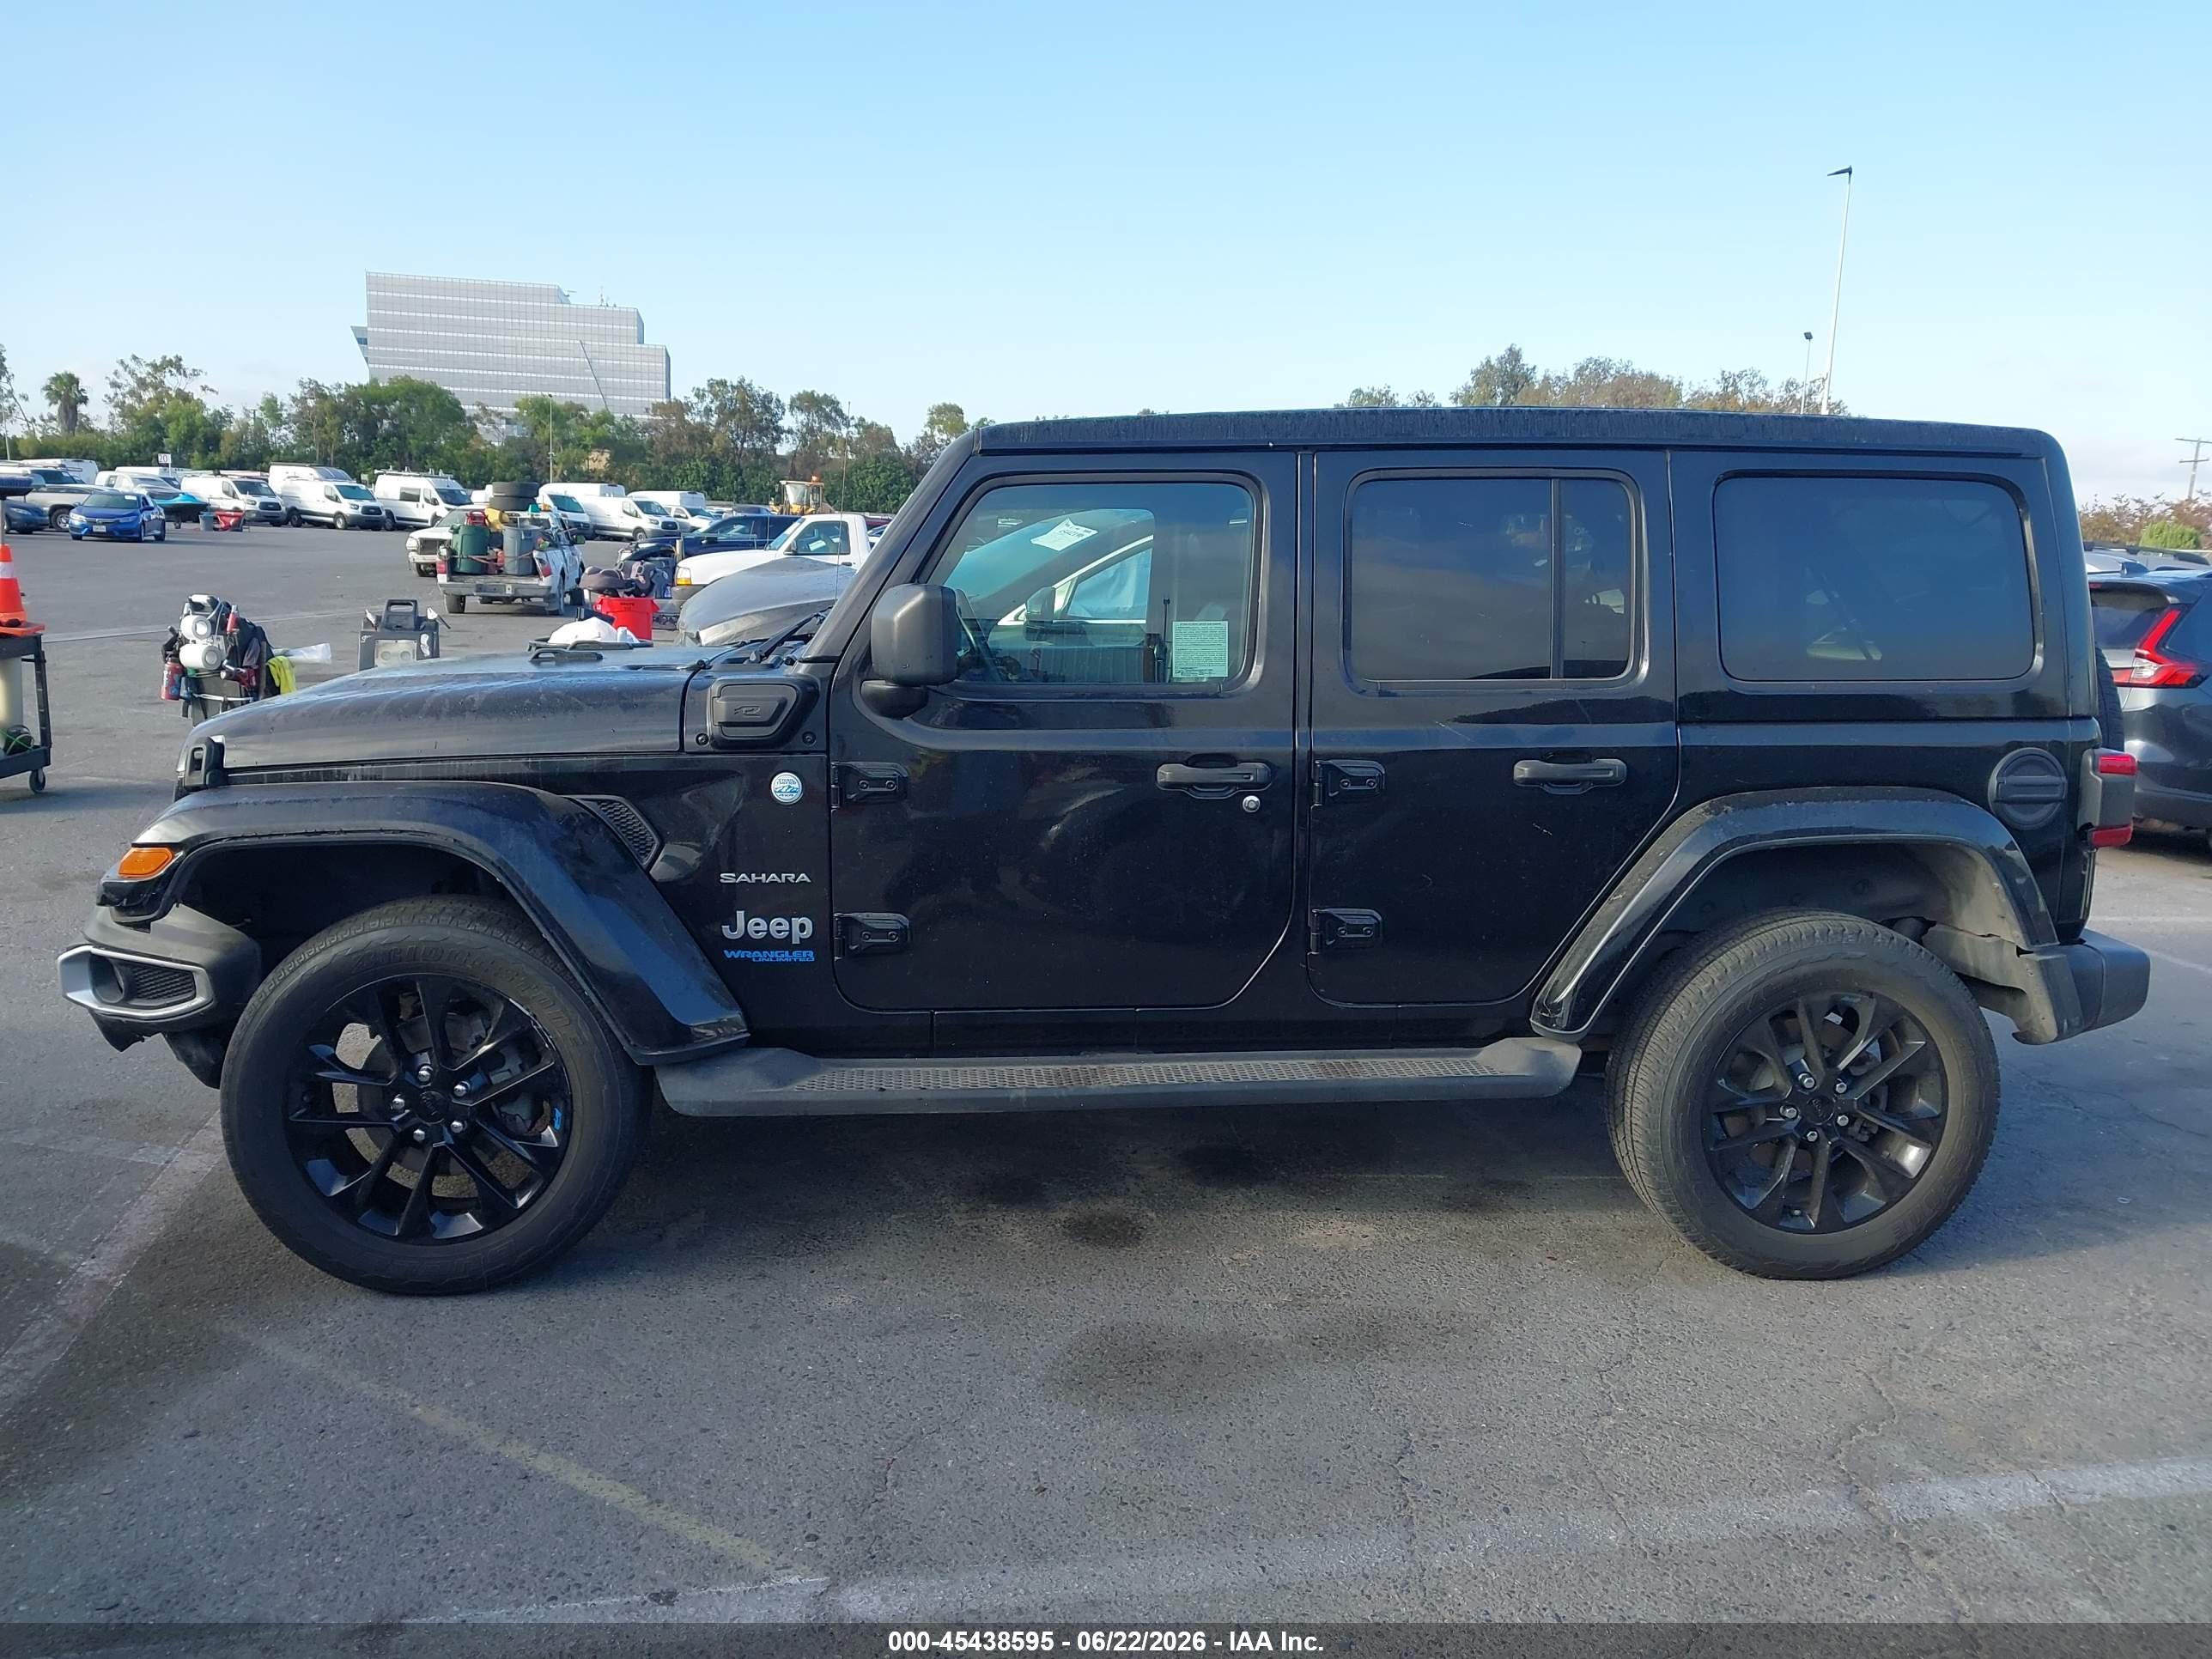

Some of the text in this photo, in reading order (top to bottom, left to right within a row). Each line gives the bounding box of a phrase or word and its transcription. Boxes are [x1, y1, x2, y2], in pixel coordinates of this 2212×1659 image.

[720, 872, 811, 884] SAHARA
[721, 910, 813, 945] Jeep
[723, 950, 815, 958] WRANGLER
